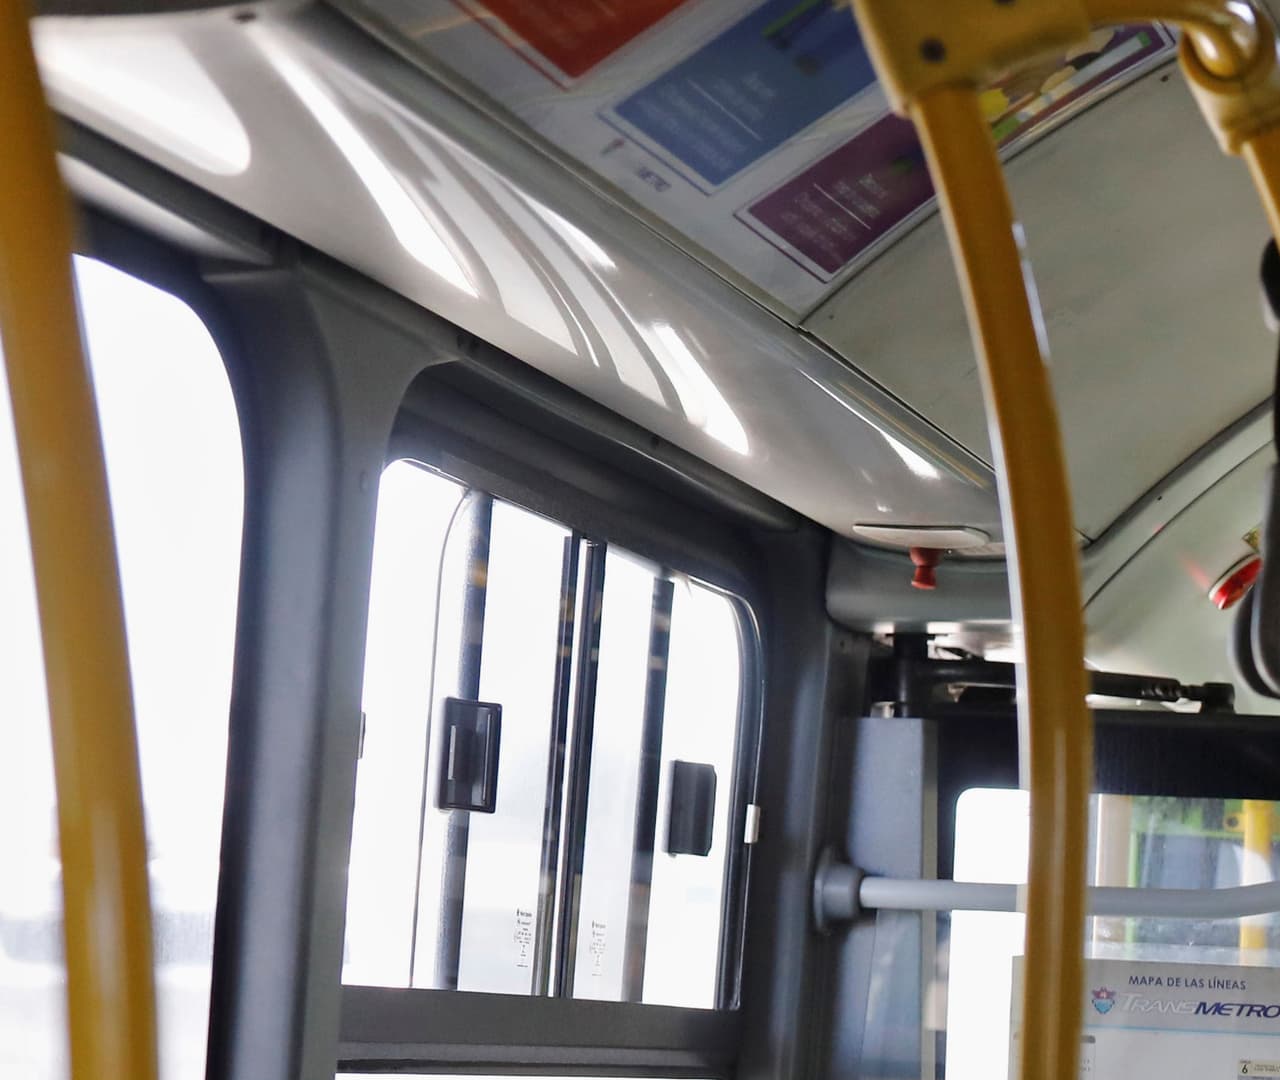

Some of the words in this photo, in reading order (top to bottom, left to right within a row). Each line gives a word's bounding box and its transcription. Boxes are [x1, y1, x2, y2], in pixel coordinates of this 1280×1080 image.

[1128, 975, 1162, 987] MAPA
[1166, 976, 1180, 988] DE
[1184, 977, 1205, 989] LAS
[1208, 975, 1247, 990] LÍNEAS
